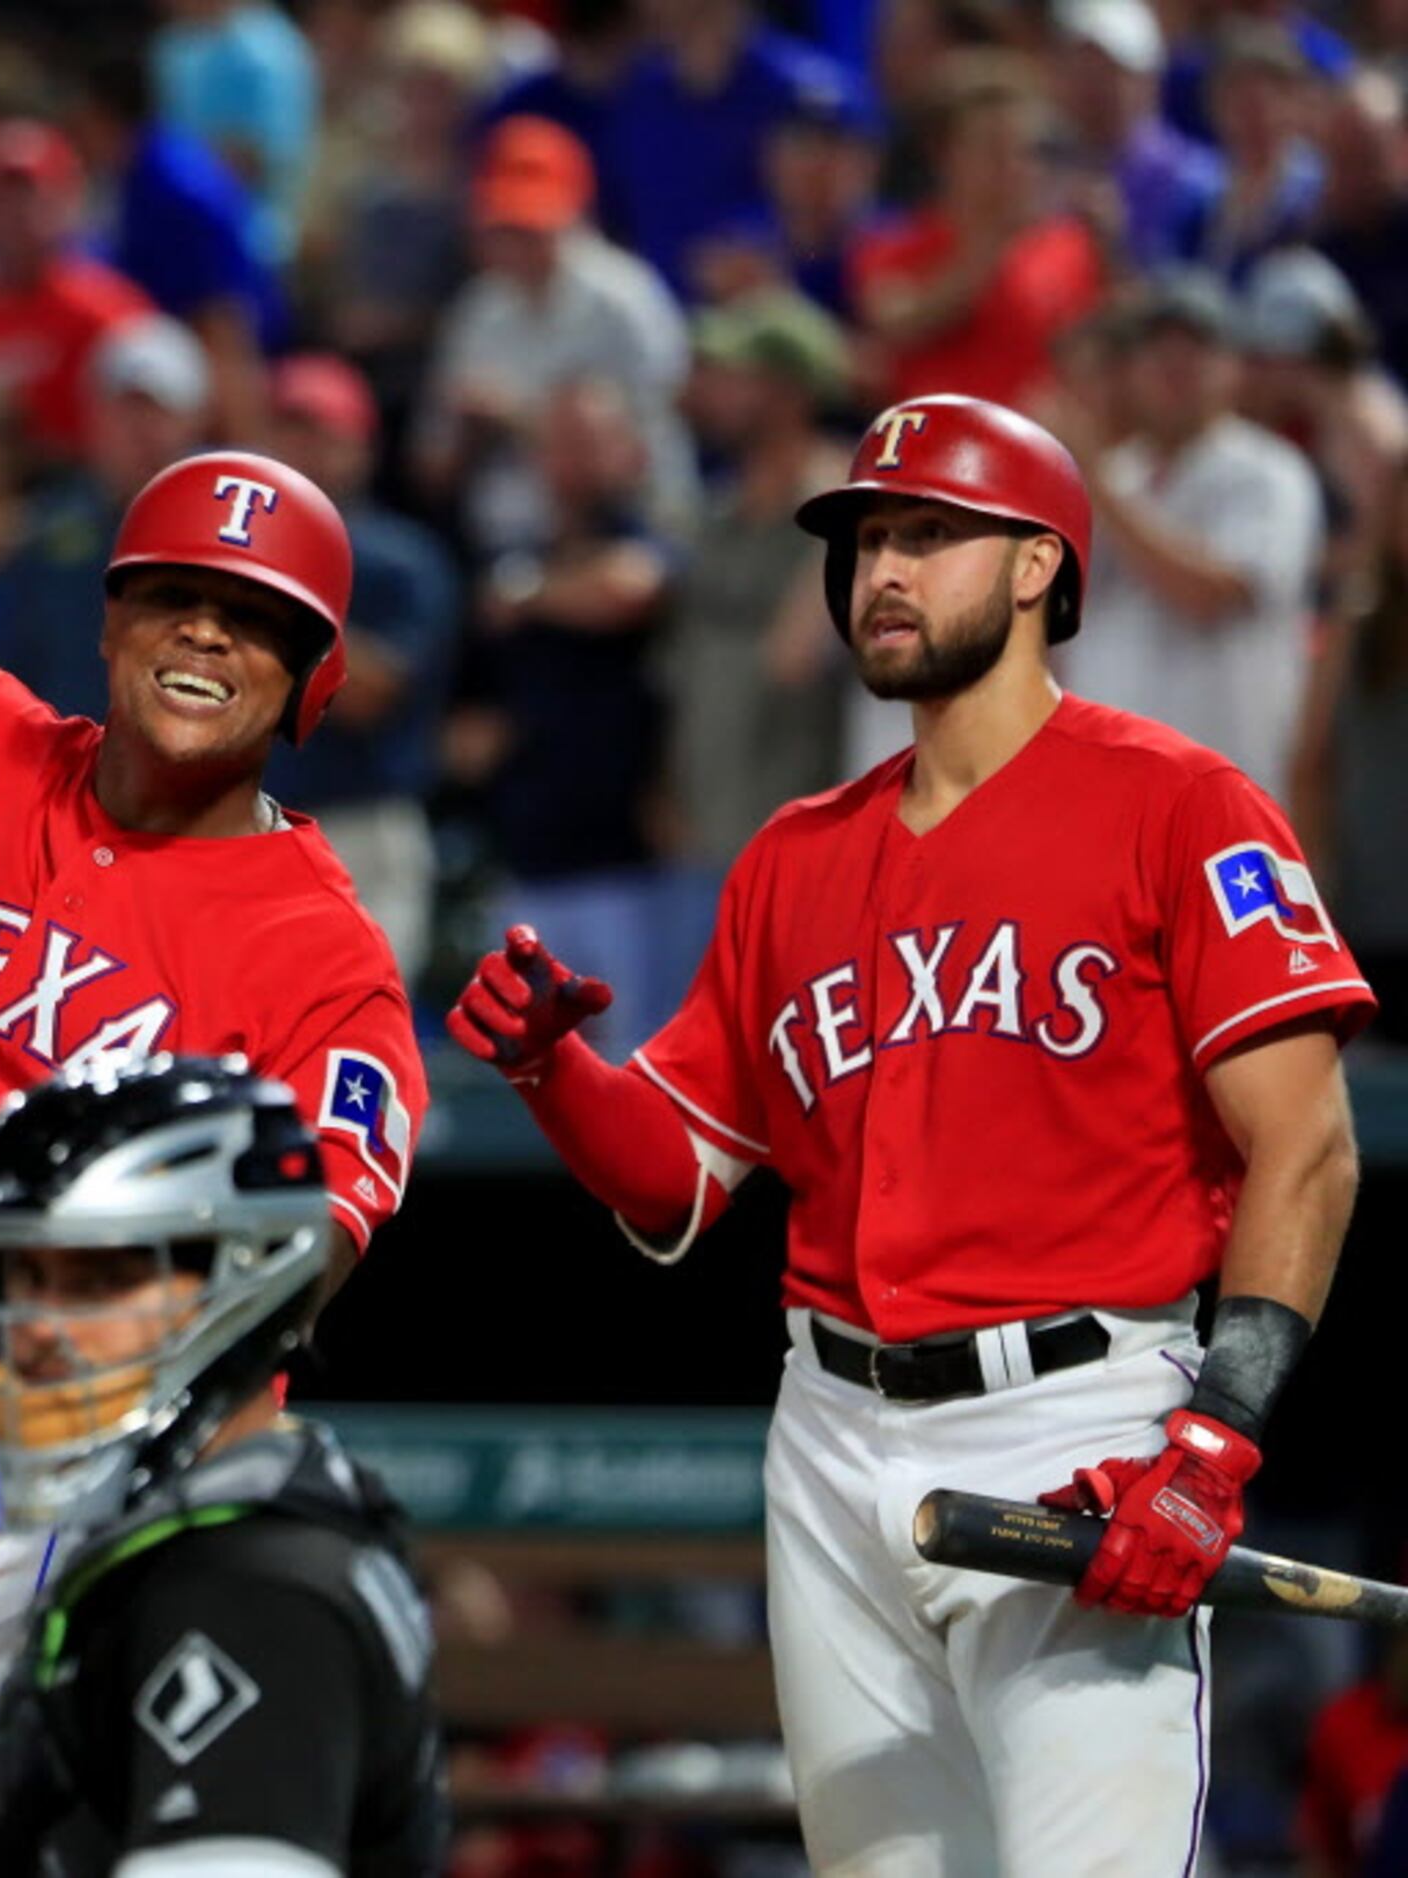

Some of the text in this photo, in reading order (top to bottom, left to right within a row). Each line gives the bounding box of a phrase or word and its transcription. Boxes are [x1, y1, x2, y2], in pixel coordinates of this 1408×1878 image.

[875, 410, 928, 472] T
[213, 473, 279, 547] T
[768, 918, 1122, 1120] TEXAS
